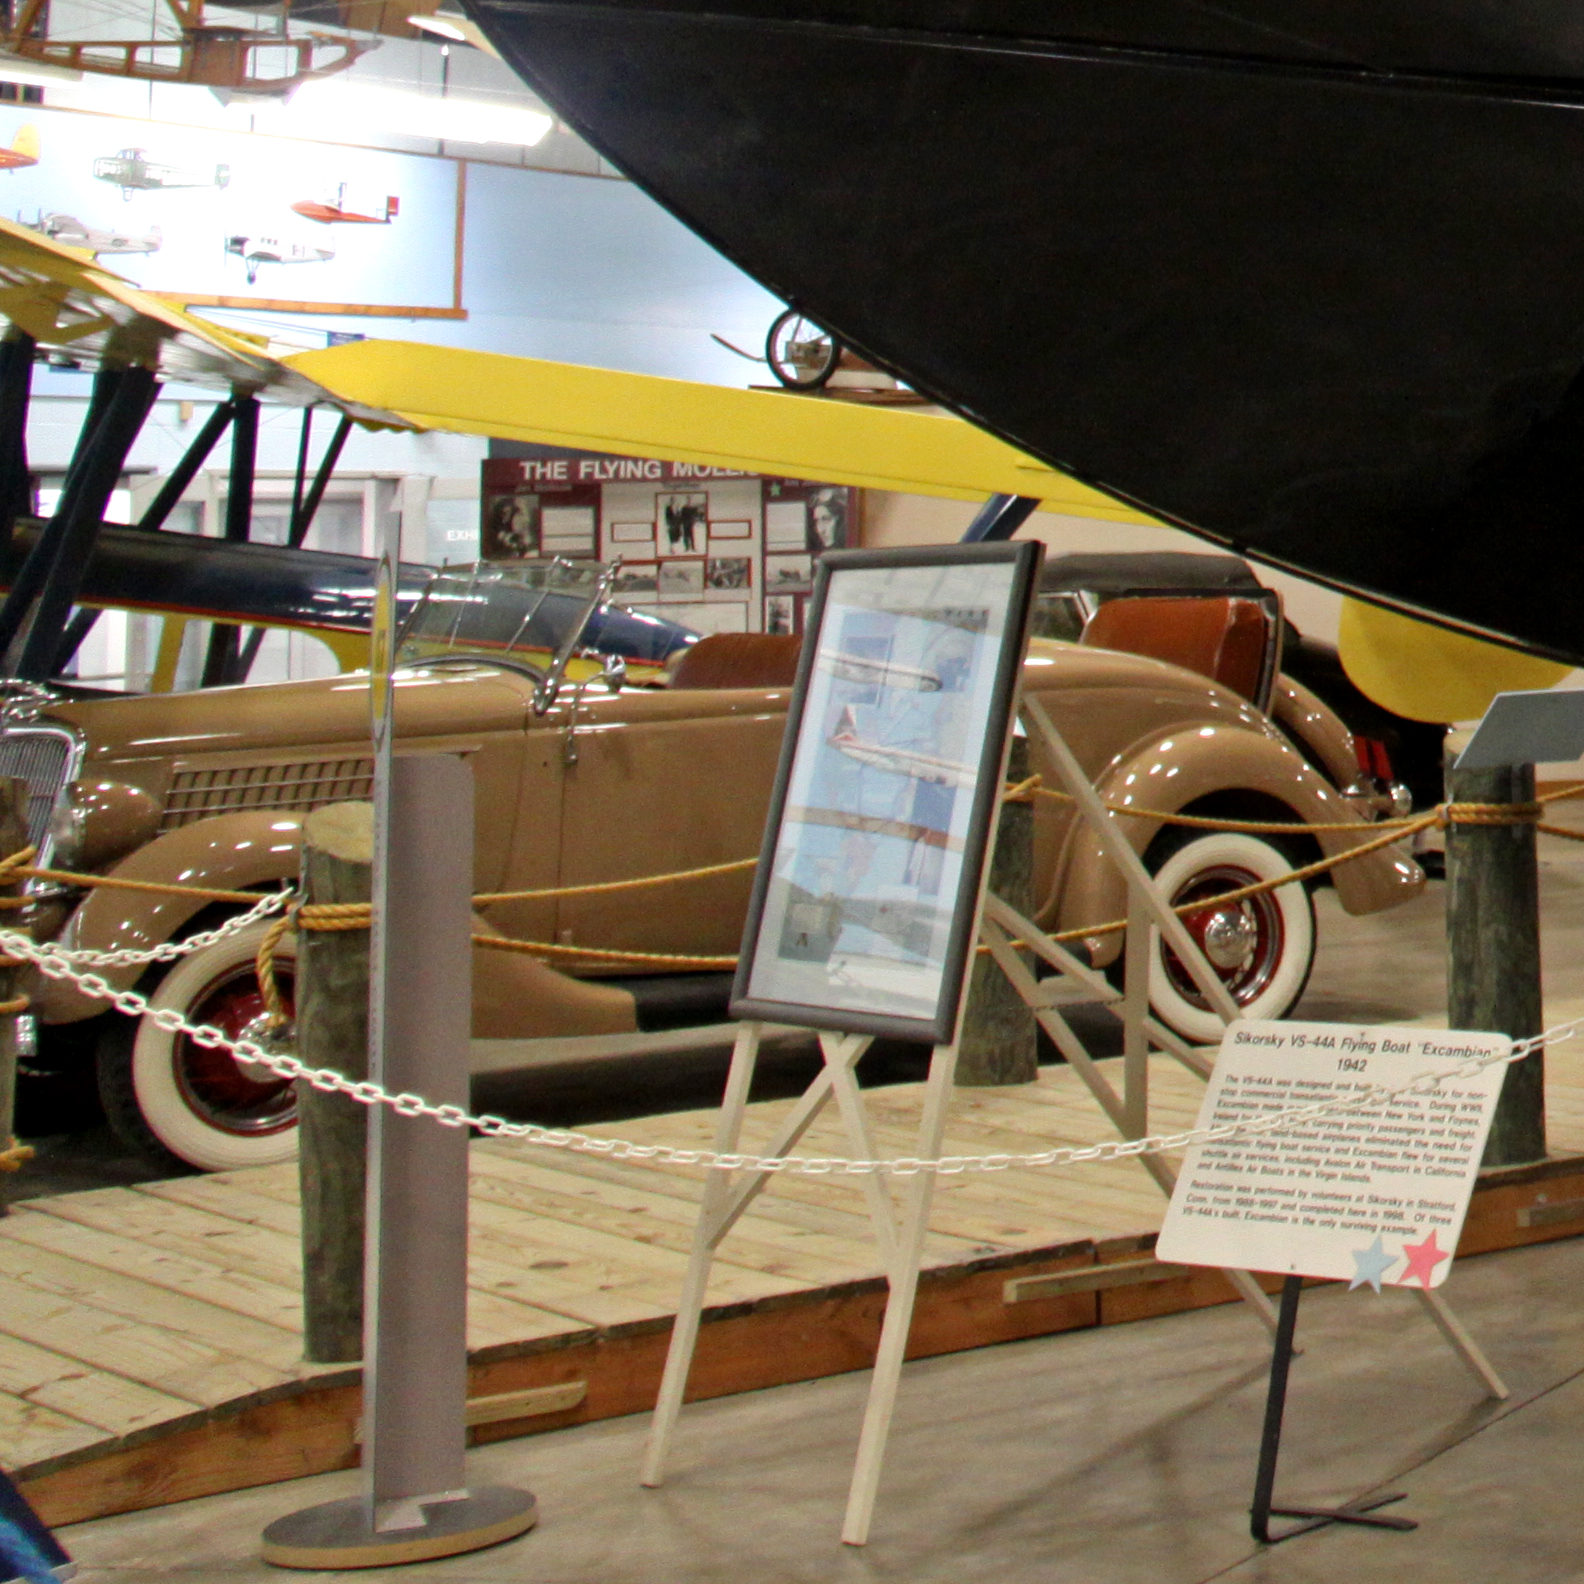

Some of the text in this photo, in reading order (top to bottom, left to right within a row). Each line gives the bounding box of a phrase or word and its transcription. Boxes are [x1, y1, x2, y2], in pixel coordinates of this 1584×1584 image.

[519, 460, 568, 480] THE
[579, 459, 662, 480] FLYING
[1235, 1031, 1285, 1048] Sikorsky
[1291, 1034, 1336, 1048] VS-44A
[1341, 1037, 1377, 1053] Flying
[1383, 1040, 1411, 1052] Boat
[1338, 1058, 1368, 1072] 1942
